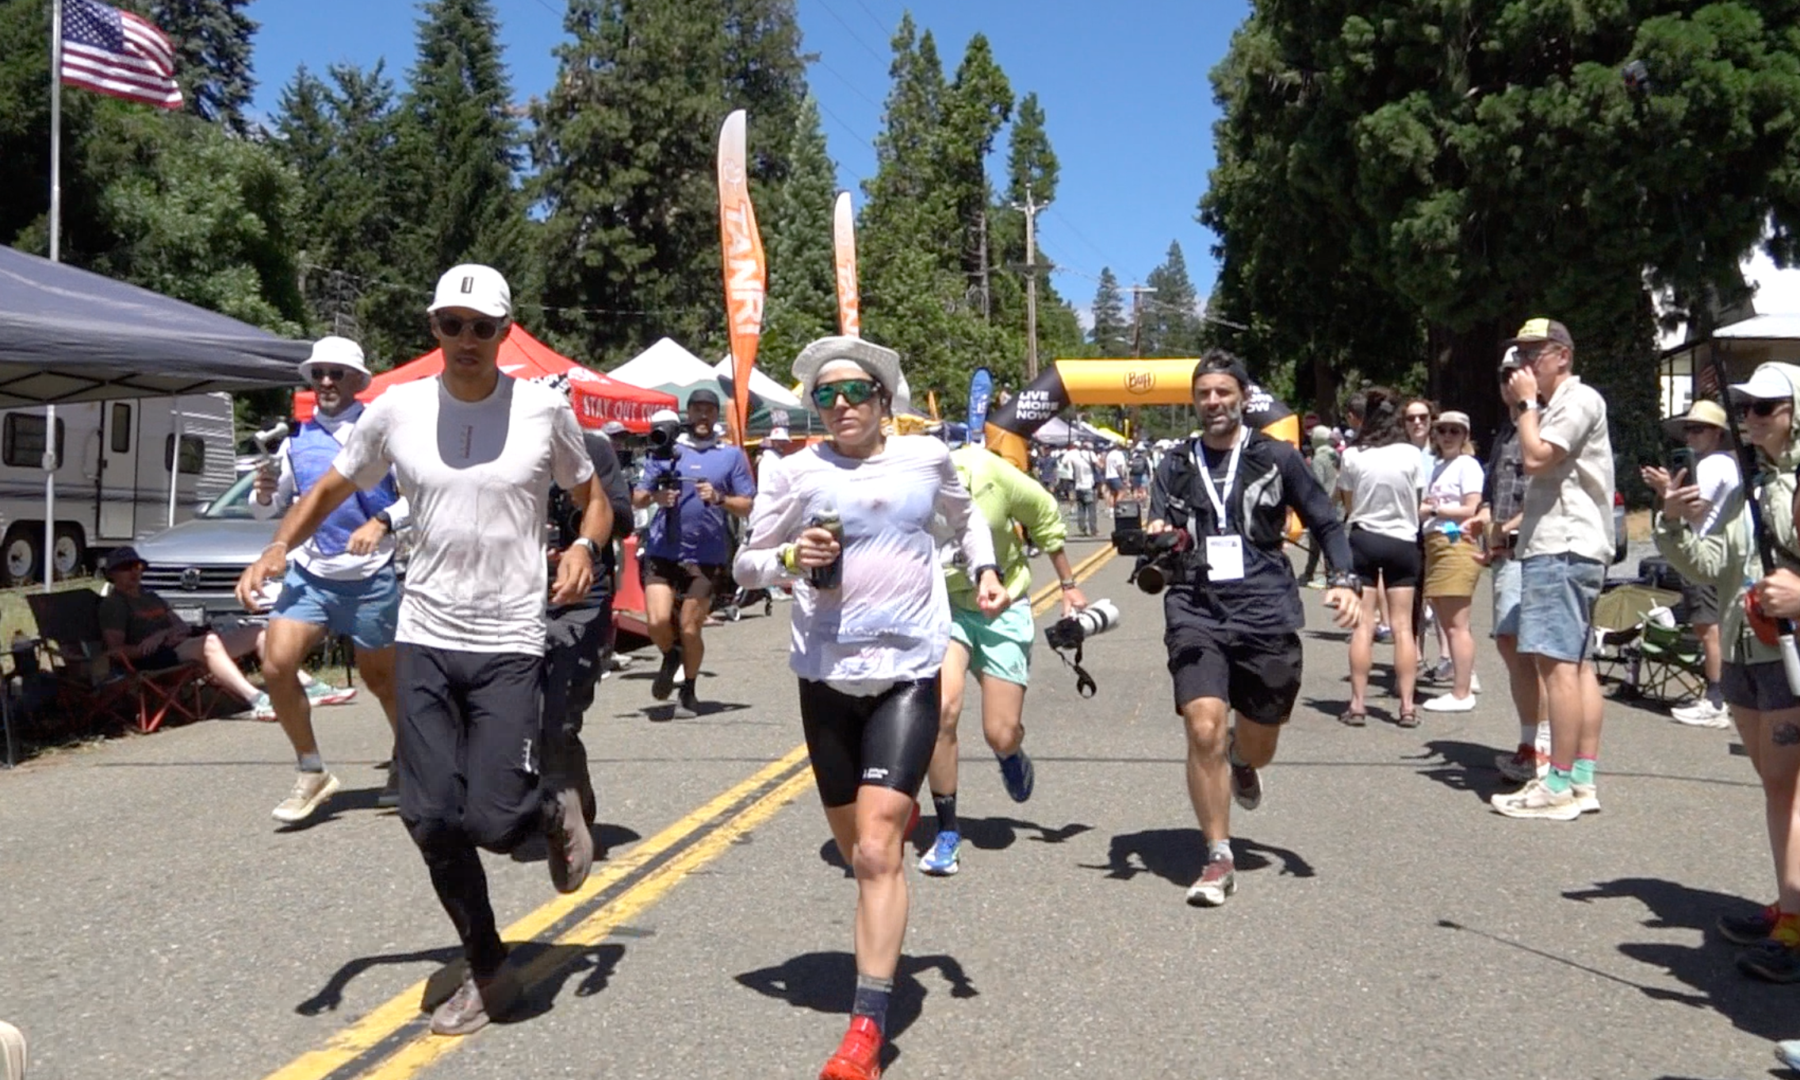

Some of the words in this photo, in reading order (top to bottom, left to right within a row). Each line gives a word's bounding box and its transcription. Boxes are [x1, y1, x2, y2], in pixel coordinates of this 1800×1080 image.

[1129, 371, 1151, 389] Buff
[1019, 390, 1050, 401] LIVE
[583, 394, 611, 420] STAY
[614, 400, 638, 423] OUT
[1016, 400, 1059, 410] MORE
[1015, 410, 1051, 420] NOW
